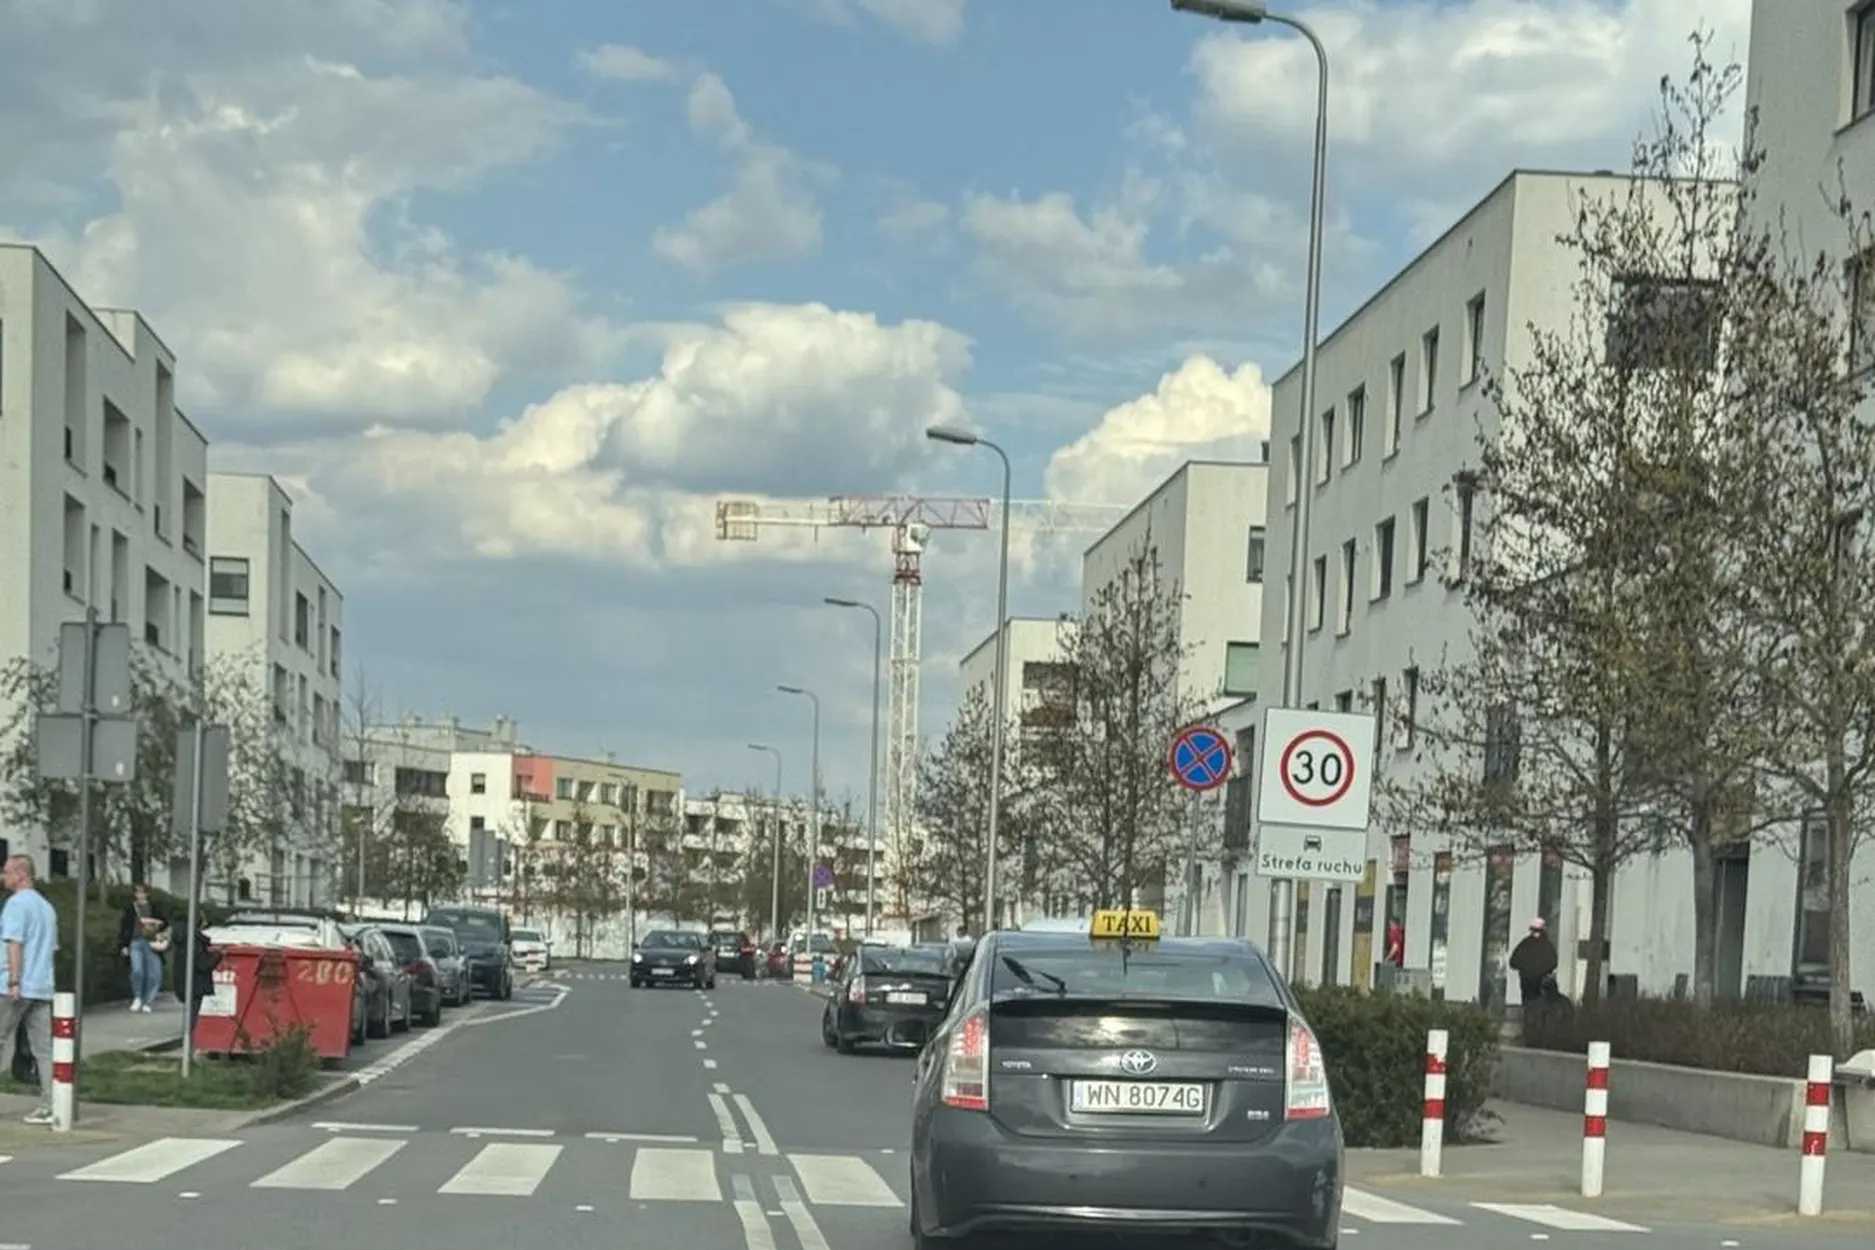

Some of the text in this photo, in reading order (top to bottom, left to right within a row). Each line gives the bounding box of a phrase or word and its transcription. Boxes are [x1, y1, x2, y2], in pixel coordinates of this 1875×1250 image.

[1292, 751, 1342, 786] 30
[1262, 854, 1363, 874] Strefa ruchu
[1102, 916, 1153, 933] TAXI
[1088, 1085, 1202, 1108] WN 8074G
